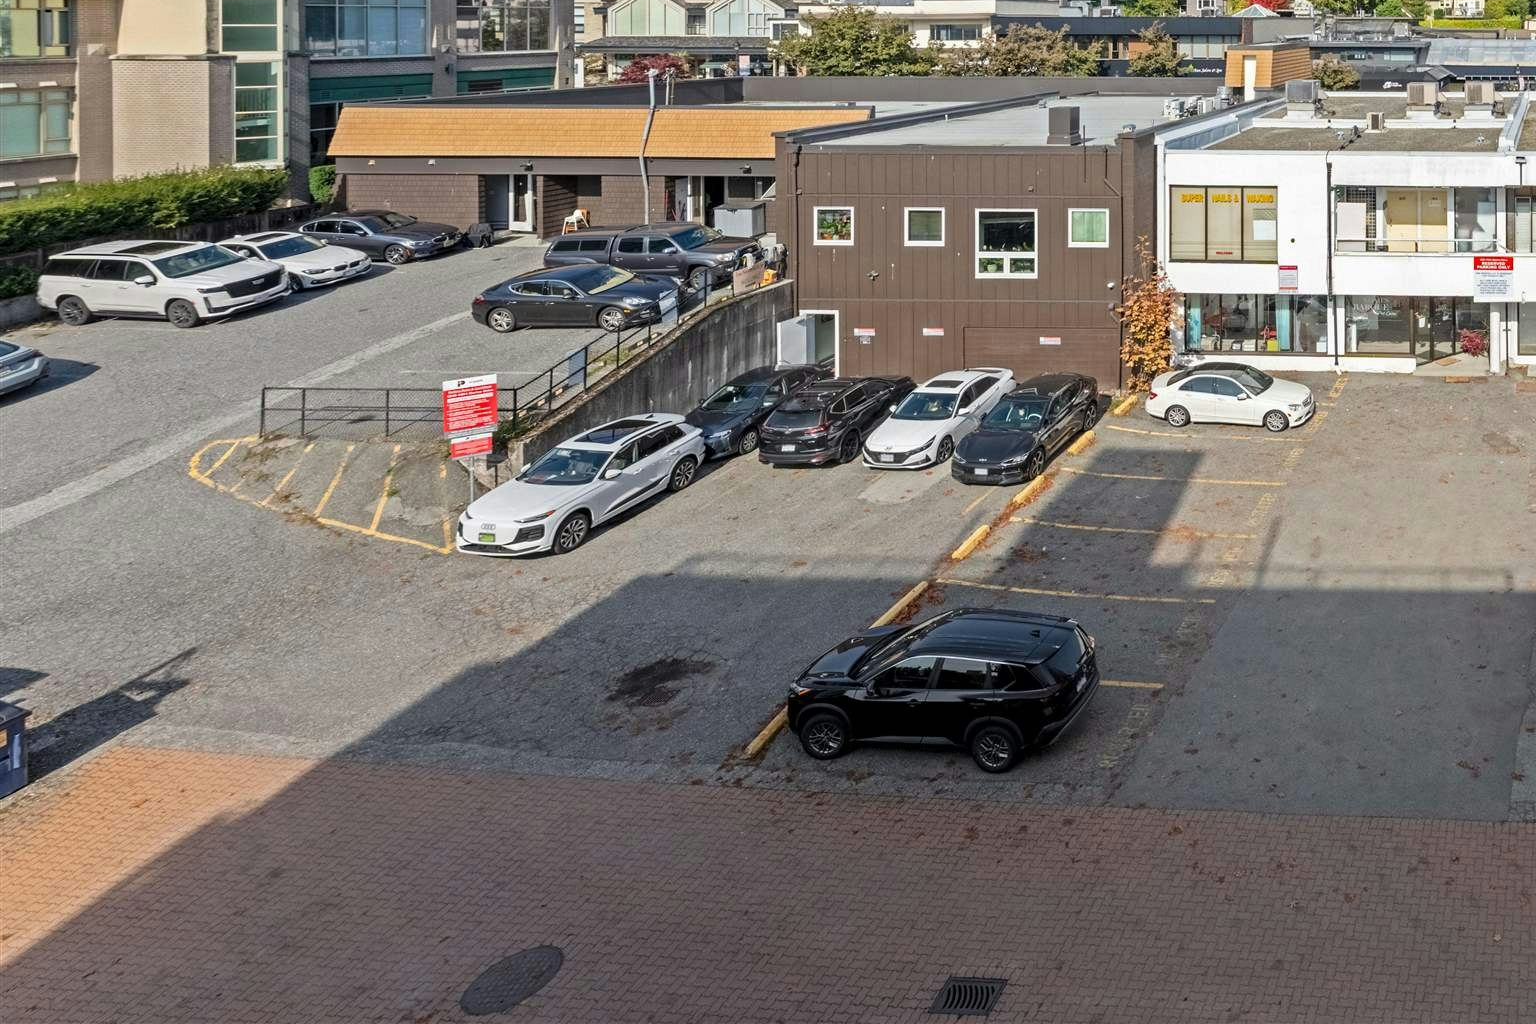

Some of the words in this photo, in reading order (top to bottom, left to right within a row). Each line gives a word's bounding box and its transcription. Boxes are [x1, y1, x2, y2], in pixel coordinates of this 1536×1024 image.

[1181, 193, 1203, 203] SUPER
[1211, 193, 1232, 203] NAILS
[1246, 193, 1274, 203] WAXING
